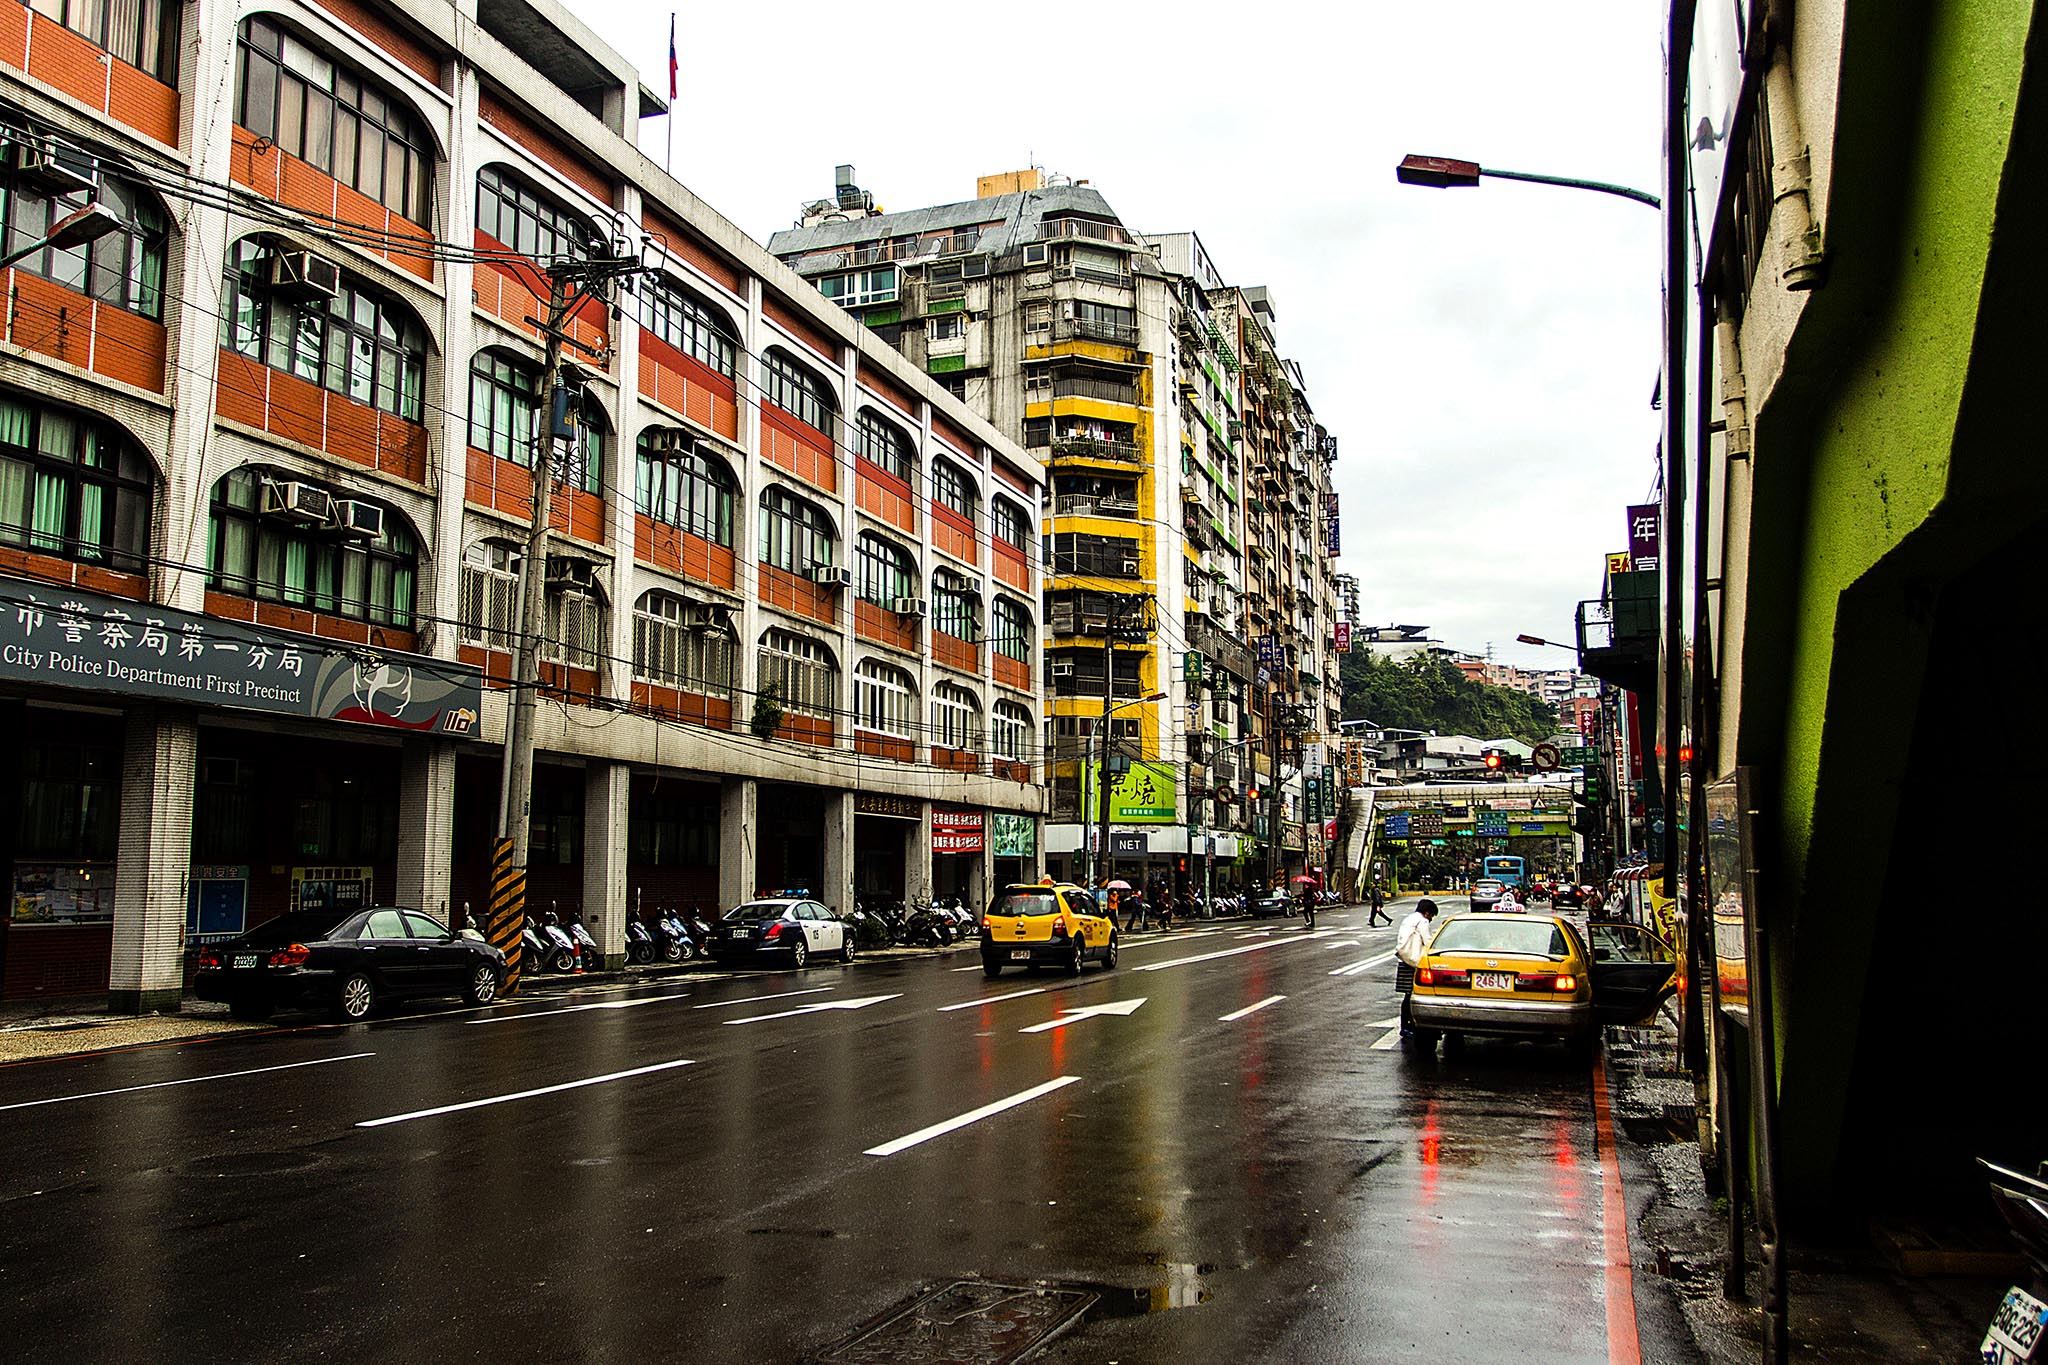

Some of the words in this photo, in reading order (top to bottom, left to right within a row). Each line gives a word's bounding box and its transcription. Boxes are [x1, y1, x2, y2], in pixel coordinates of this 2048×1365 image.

[0, 594, 303, 678] 市警察局第一分局
[3, 645, 43, 669] City
[48, 651, 102, 675] Police
[107, 660, 202, 690] Department
[206, 675, 241, 695] First
[245, 680, 301, 703] Precinct
[1119, 840, 1140, 850] NET
[1475, 975, 1510, 987] 246-LY
